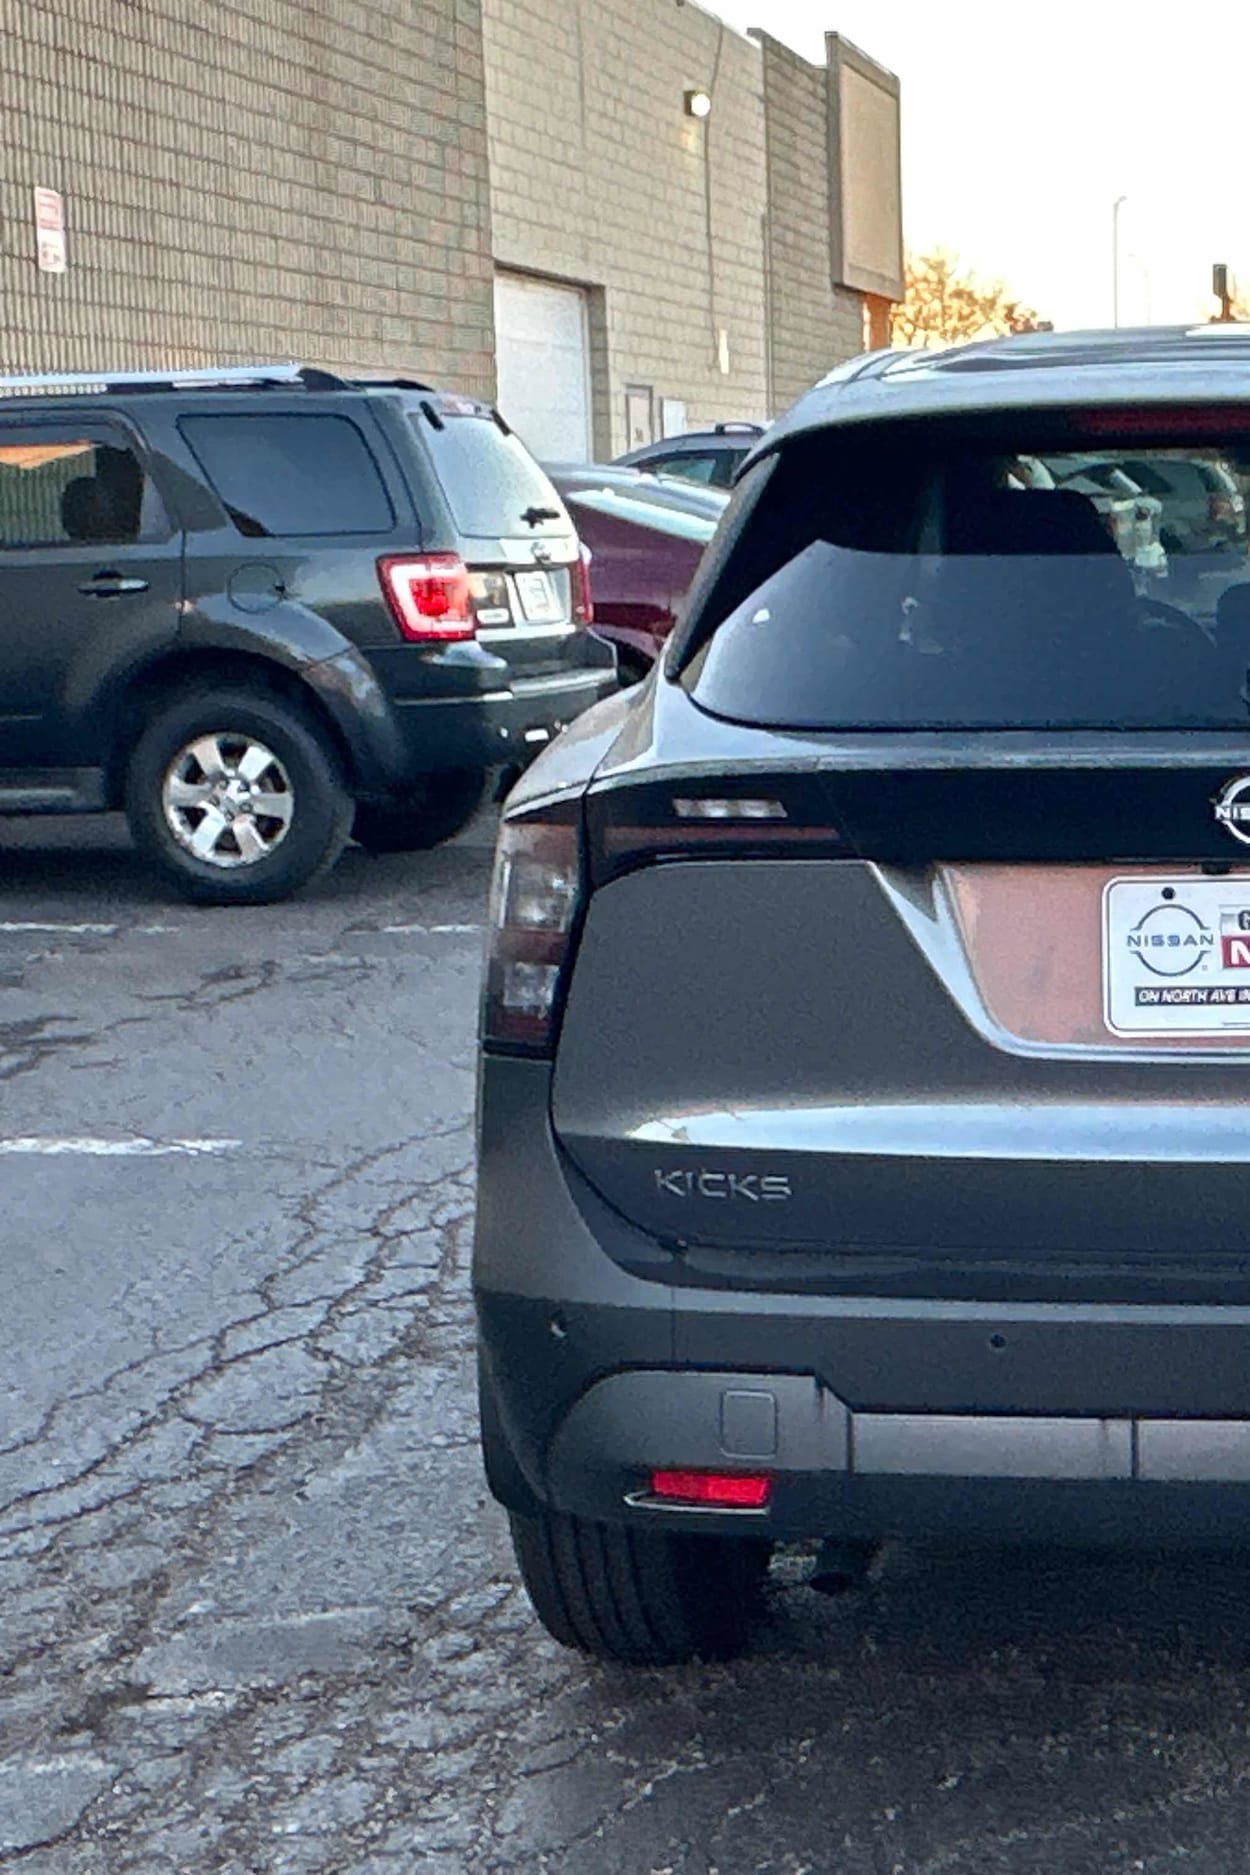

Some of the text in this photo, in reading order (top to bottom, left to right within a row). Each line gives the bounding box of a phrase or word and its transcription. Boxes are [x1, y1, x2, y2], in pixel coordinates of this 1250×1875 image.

[1126, 934, 1214, 947] NISSAN
[1138, 988, 1160, 1003] ON
[1161, 988, 1208, 1003] NORTH
[654, 1168, 792, 1200] KICKS
